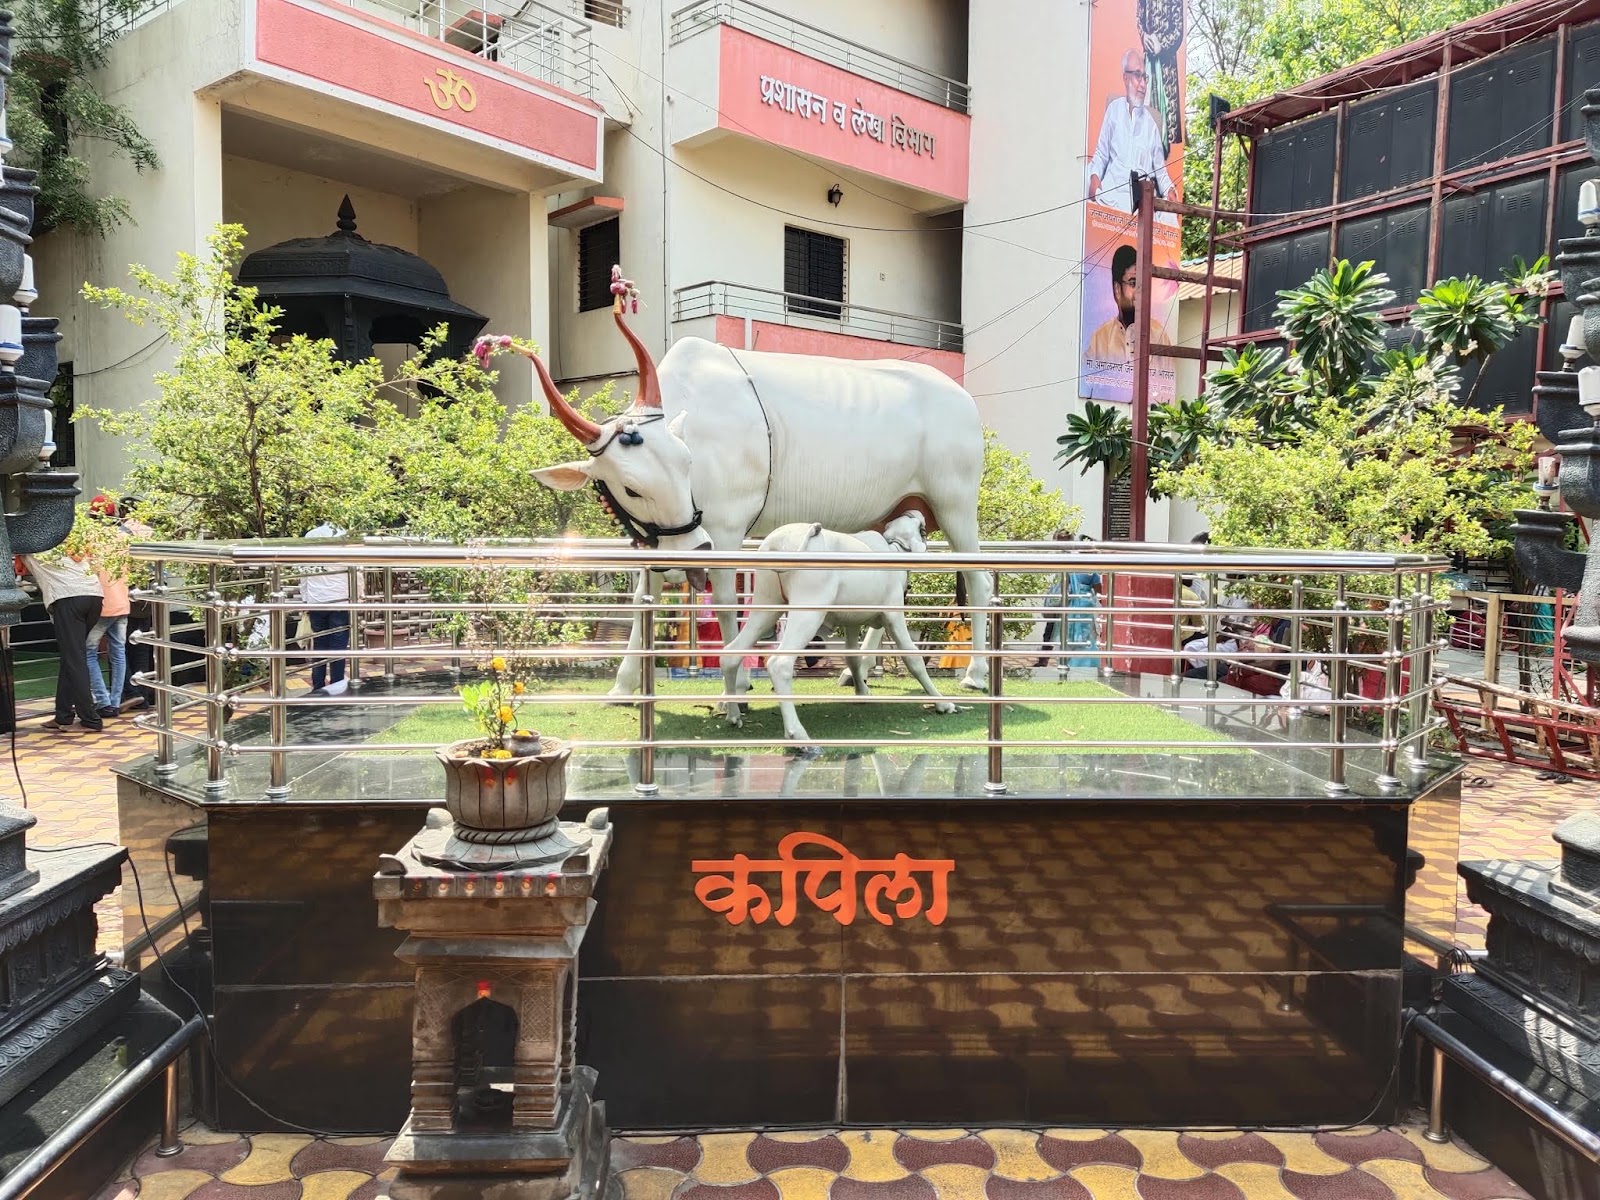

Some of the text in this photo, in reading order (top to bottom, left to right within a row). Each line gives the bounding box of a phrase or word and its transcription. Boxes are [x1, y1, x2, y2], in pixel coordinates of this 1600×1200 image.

[760, 75, 936, 158] प्रशासन व लेखा विभाग
[692, 832, 955, 926] कपिला
